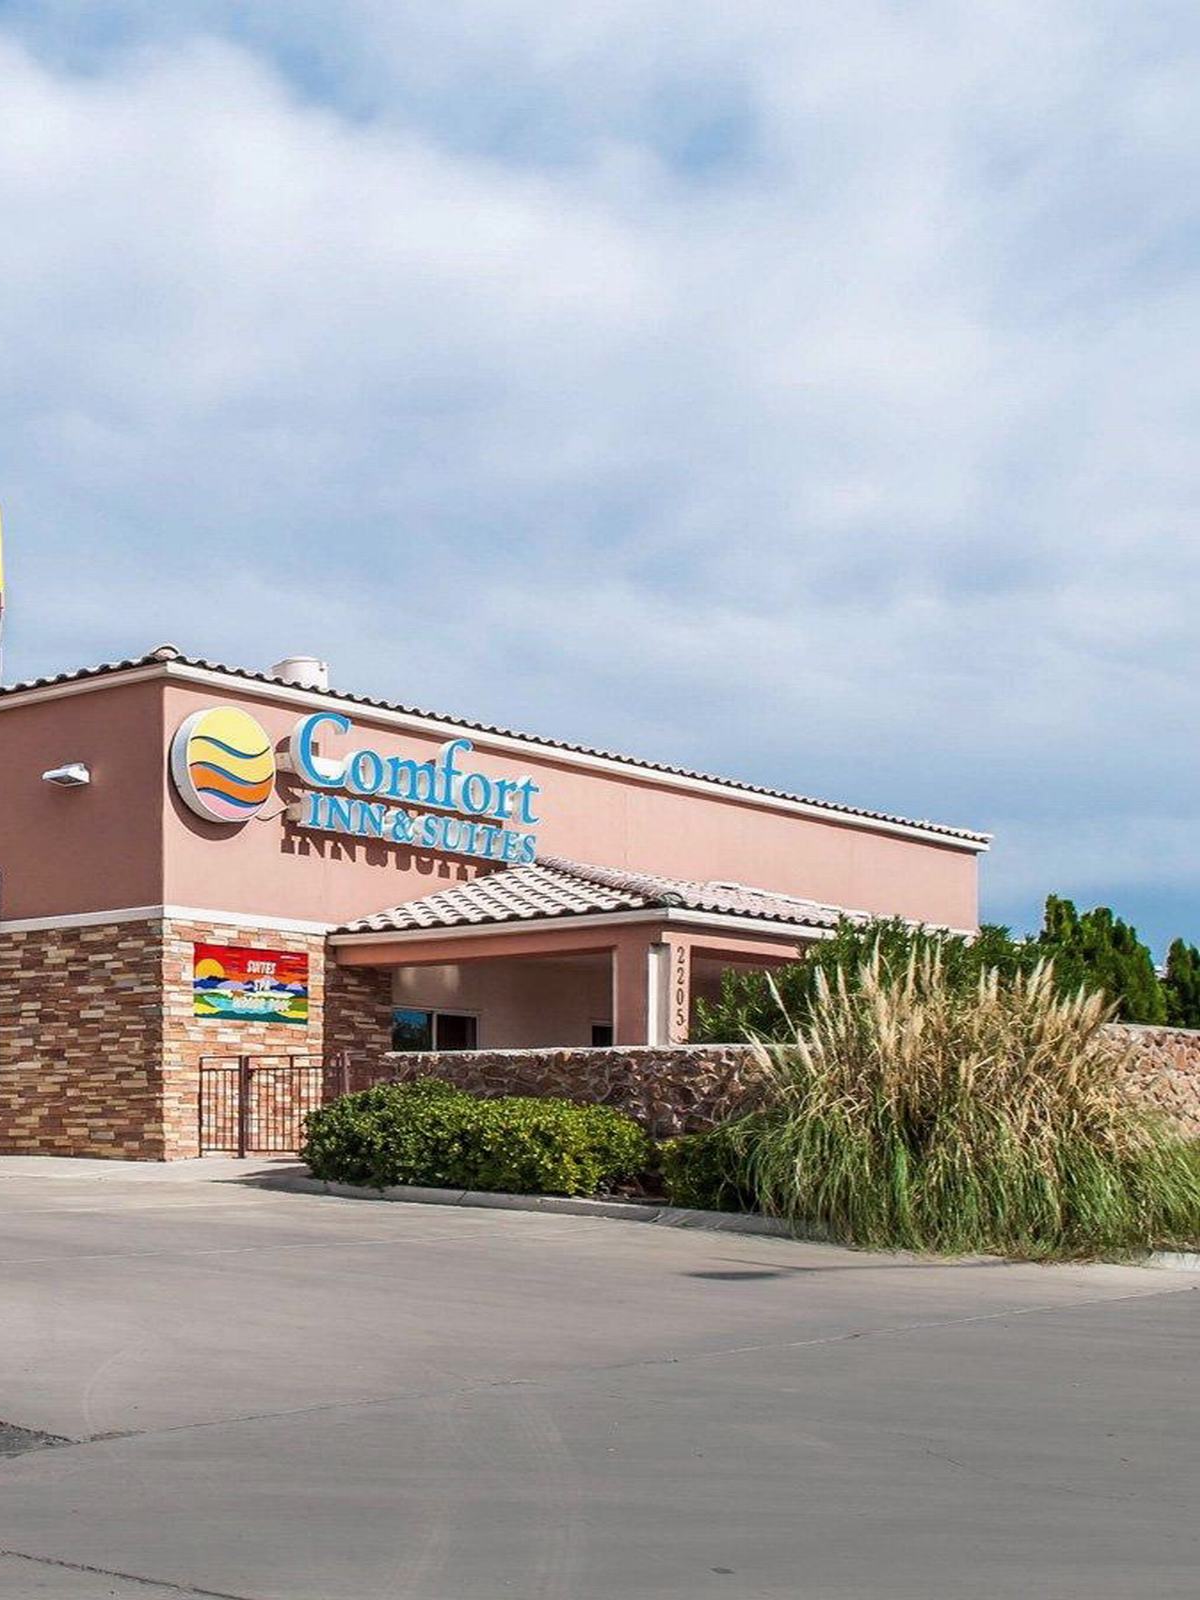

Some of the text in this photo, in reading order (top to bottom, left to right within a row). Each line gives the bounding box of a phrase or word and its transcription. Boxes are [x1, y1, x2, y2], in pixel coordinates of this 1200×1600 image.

[299, 711, 540, 824] Comfort
[308, 792, 386, 836] INN
[421, 815, 536, 864] SUITES
